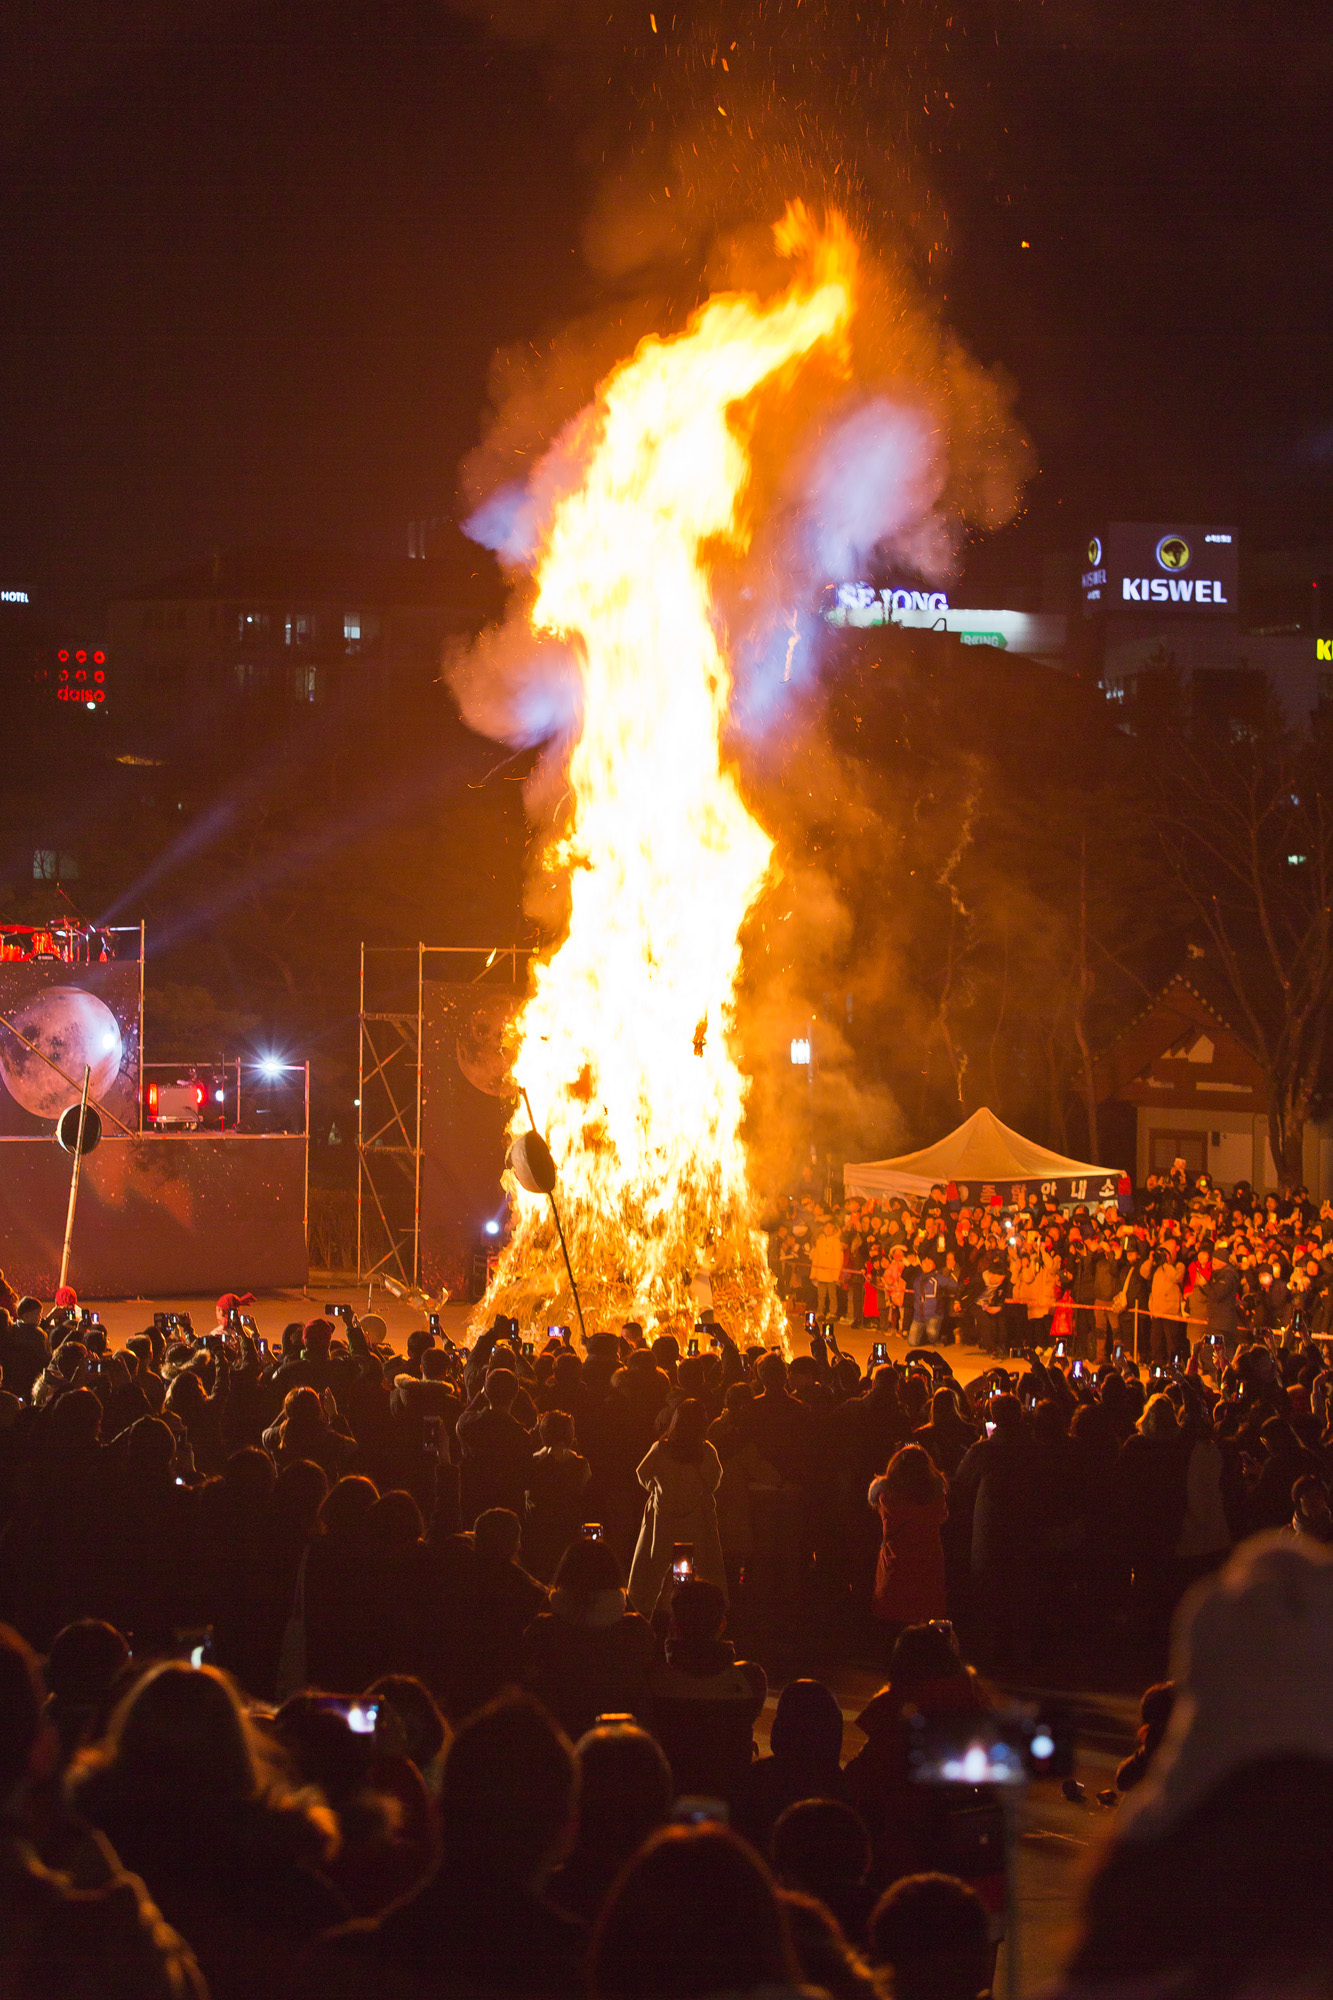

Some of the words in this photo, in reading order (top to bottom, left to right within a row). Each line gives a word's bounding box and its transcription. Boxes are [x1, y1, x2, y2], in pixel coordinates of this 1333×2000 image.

[1, 591, 29, 603] HOTEL
[1122, 578, 1227, 603] KISWEL
[1316, 638, 1333, 661] K
